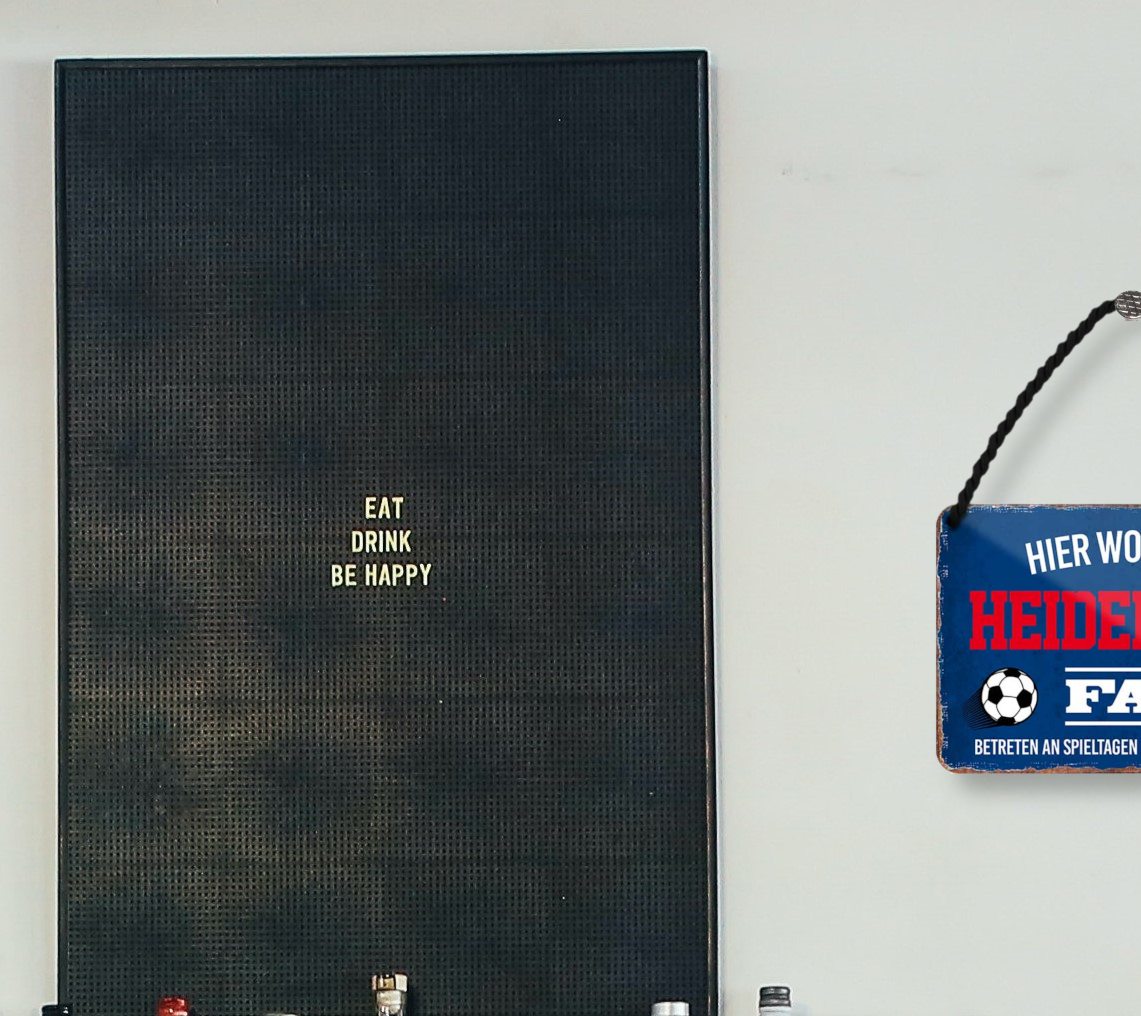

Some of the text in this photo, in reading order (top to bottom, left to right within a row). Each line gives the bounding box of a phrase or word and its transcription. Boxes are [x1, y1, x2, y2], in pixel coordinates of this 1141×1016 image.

[364, 496, 404, 520] EAT
[351, 529, 412, 553] DRINK
[1025, 533, 1092, 575] HIER
[331, 563, 432, 587] BE HAPPY
[974, 738, 1040, 756] BETRETEN
[1042, 738, 1060, 756] AN
[1063, 738, 1138, 756] SPIELTAGEN
